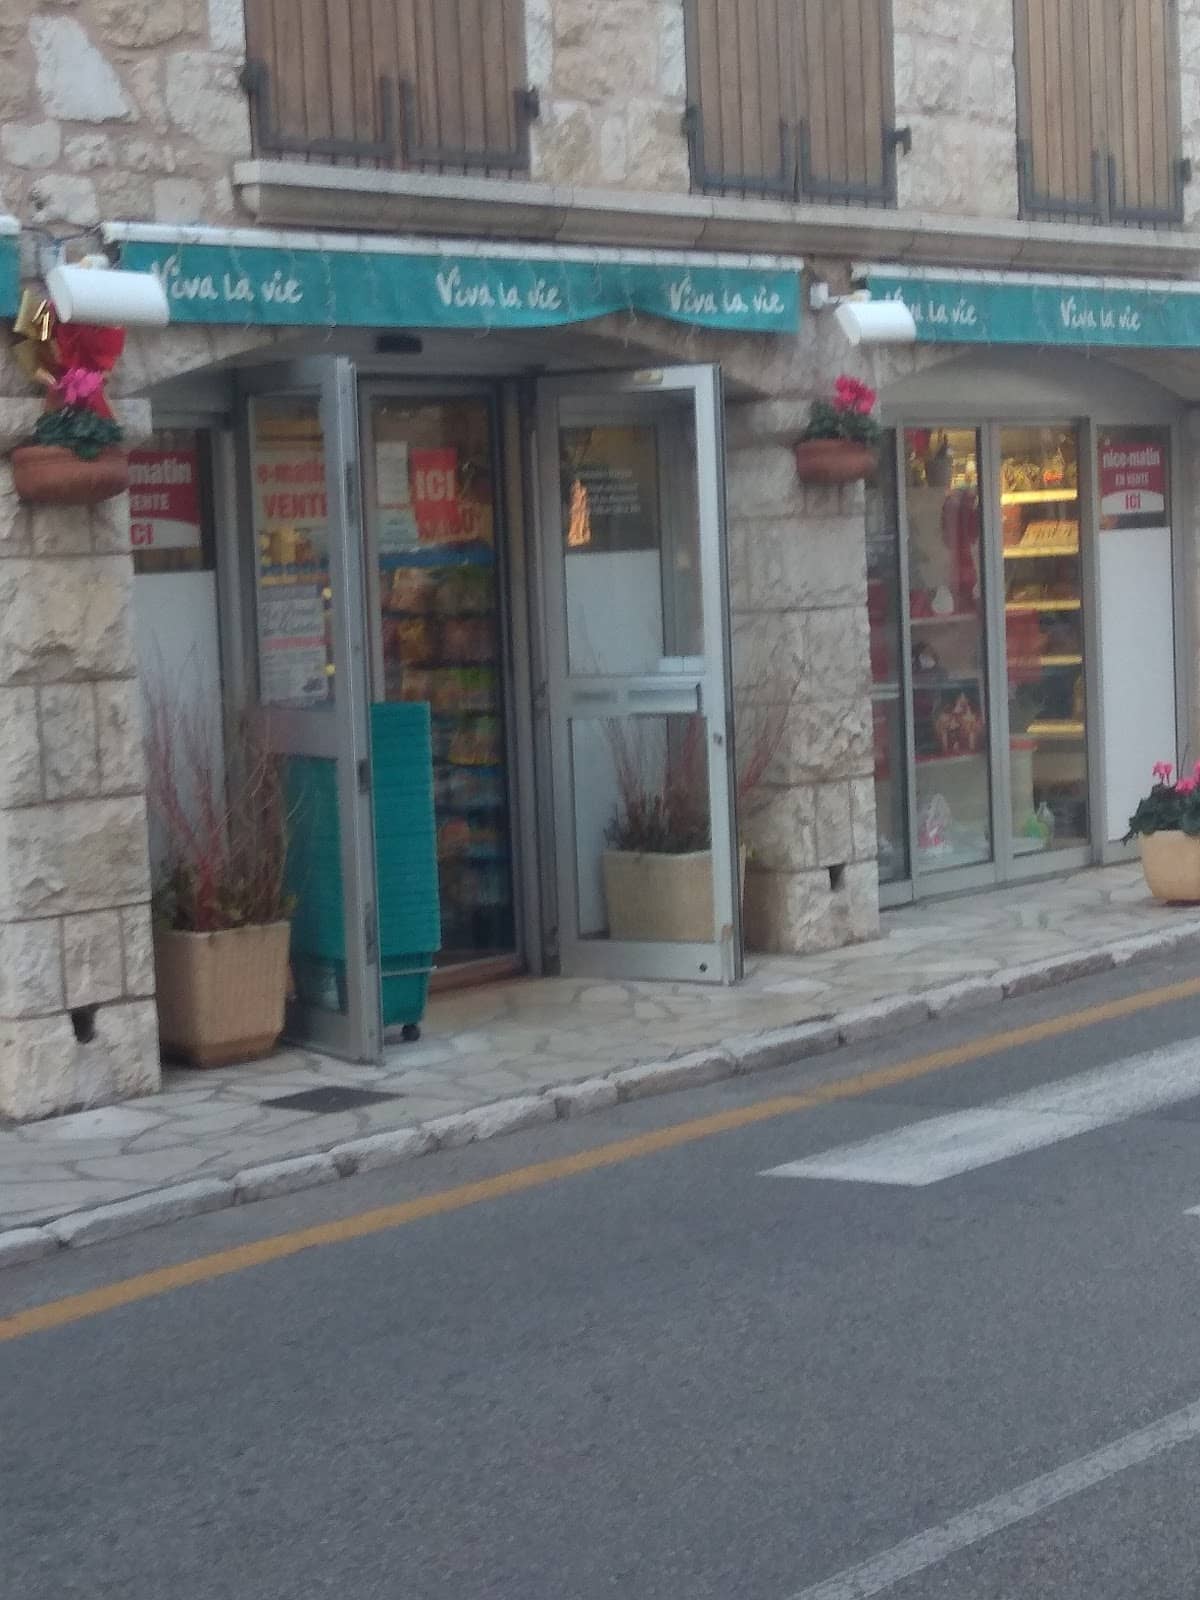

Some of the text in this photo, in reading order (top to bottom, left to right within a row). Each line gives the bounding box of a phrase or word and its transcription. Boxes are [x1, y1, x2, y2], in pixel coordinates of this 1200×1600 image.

[261, 270, 303, 303] vie
[437, 265, 496, 308] Viva
[528, 278, 562, 310] vie
[670, 273, 718, 314] Viva
[752, 285, 785, 314] vie
[951, 298, 977, 326] vie
[1060, 295, 1097, 329] Viva
[1119, 304, 1141, 331] vie
[127, 458, 193, 485] matin
[1103, 447, 1161, 469] nice-matin
[415, 467, 457, 502] ICI
[129, 492, 170, 512] ENTE
[1125, 493, 1142, 511] ICI
[129, 522, 153, 546] CI
